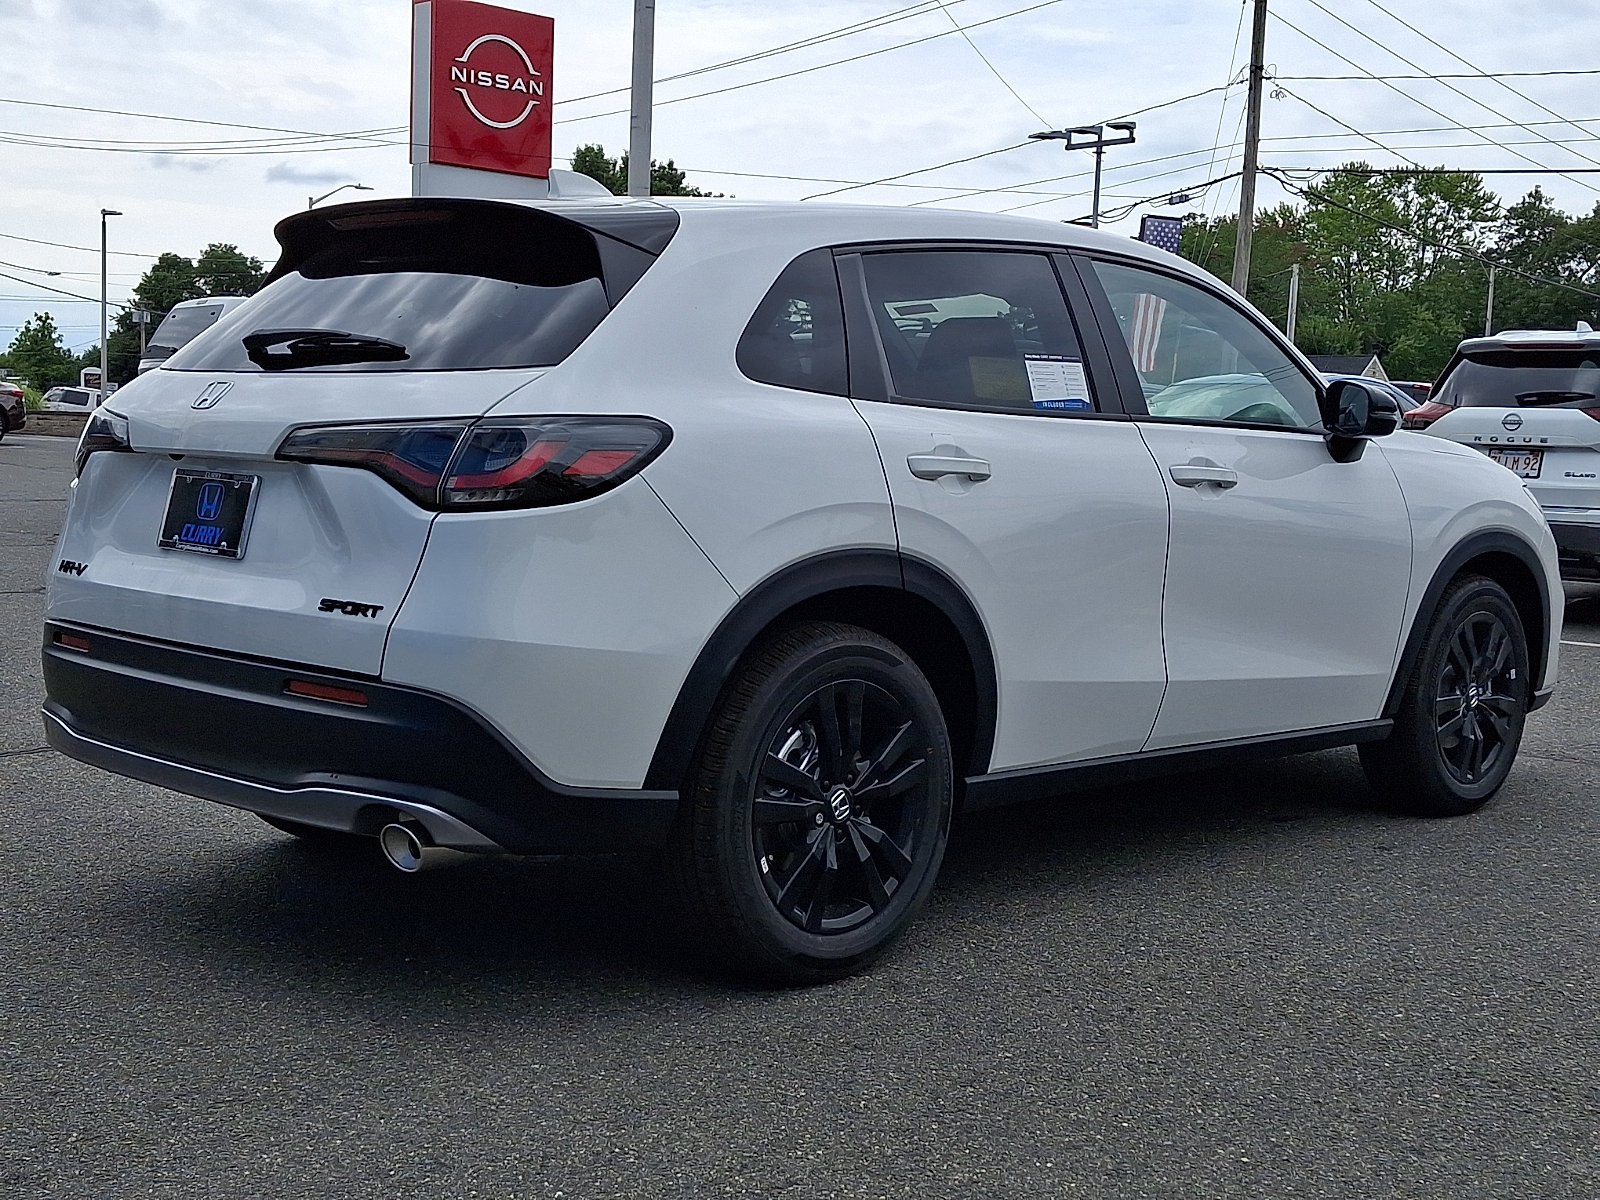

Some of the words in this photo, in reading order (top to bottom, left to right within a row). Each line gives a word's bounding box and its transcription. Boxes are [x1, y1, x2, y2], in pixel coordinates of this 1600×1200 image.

[451, 66, 543, 96] NISSAN
[1523, 457, 1539, 471] 92
[181, 523, 224, 545] CURRY
[58, 559, 89, 577] HR-V
[317, 598, 384, 618] SPORT
